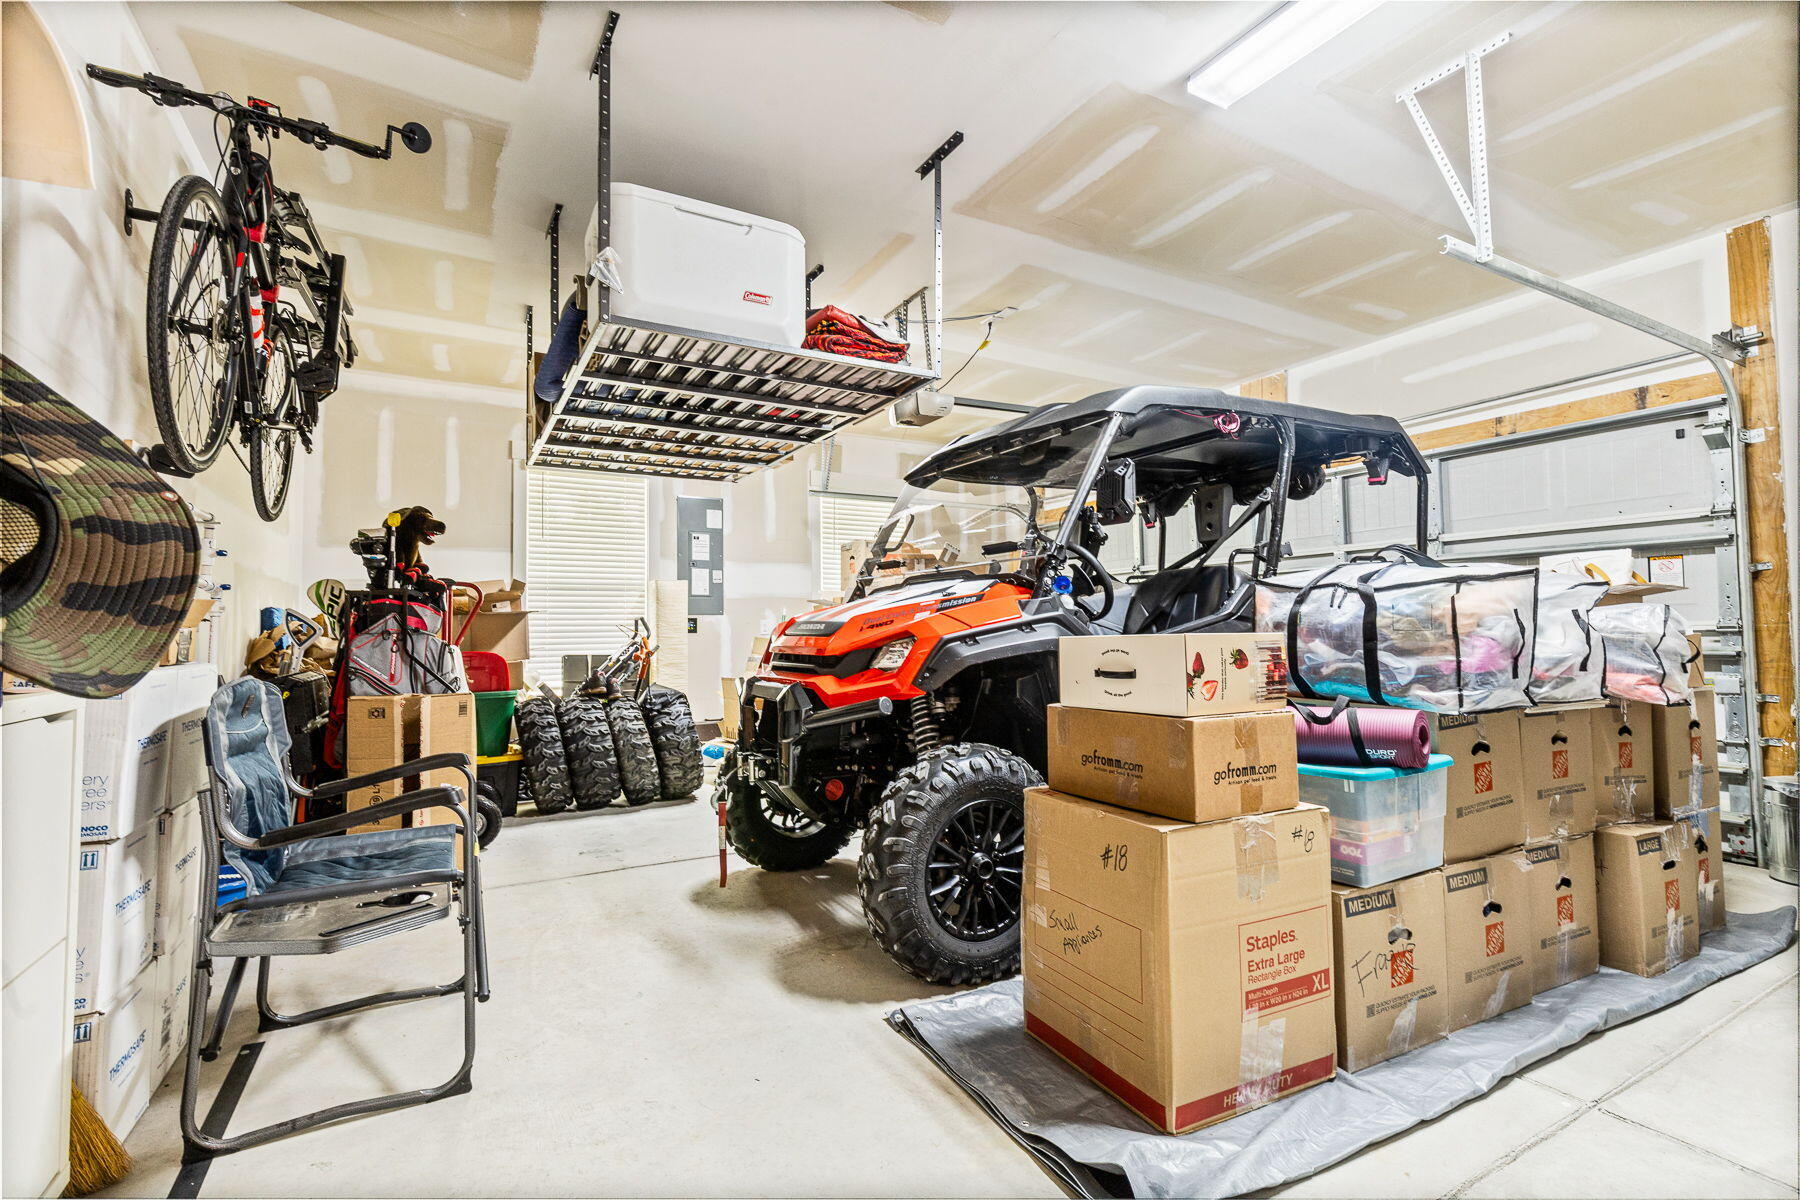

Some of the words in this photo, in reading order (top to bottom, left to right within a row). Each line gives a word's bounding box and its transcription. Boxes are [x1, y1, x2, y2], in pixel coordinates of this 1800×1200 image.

[1082, 749, 1144, 773] gofromm.com
[82, 775, 109, 787] ery
[1214, 762, 1277, 785] gofromm.com
[1291, 824, 1315, 853] #18
[1639, 838, 1660, 852] LARGE
[1100, 843, 1128, 872] #18
[1449, 871, 1485, 890] MEDIUM
[1348, 892, 1392, 914] MEDIUM
[1246, 929, 1296, 953] Staples
[1247, 957, 1275, 973] Extra
[1277, 949, 1306, 966] Large
[1247, 969, 1282, 985] Rectangle
[1283, 964, 1297, 975] Box
[1312, 972, 1330, 993] XL
[1248, 986, 1280, 1001] Multi-Depth
